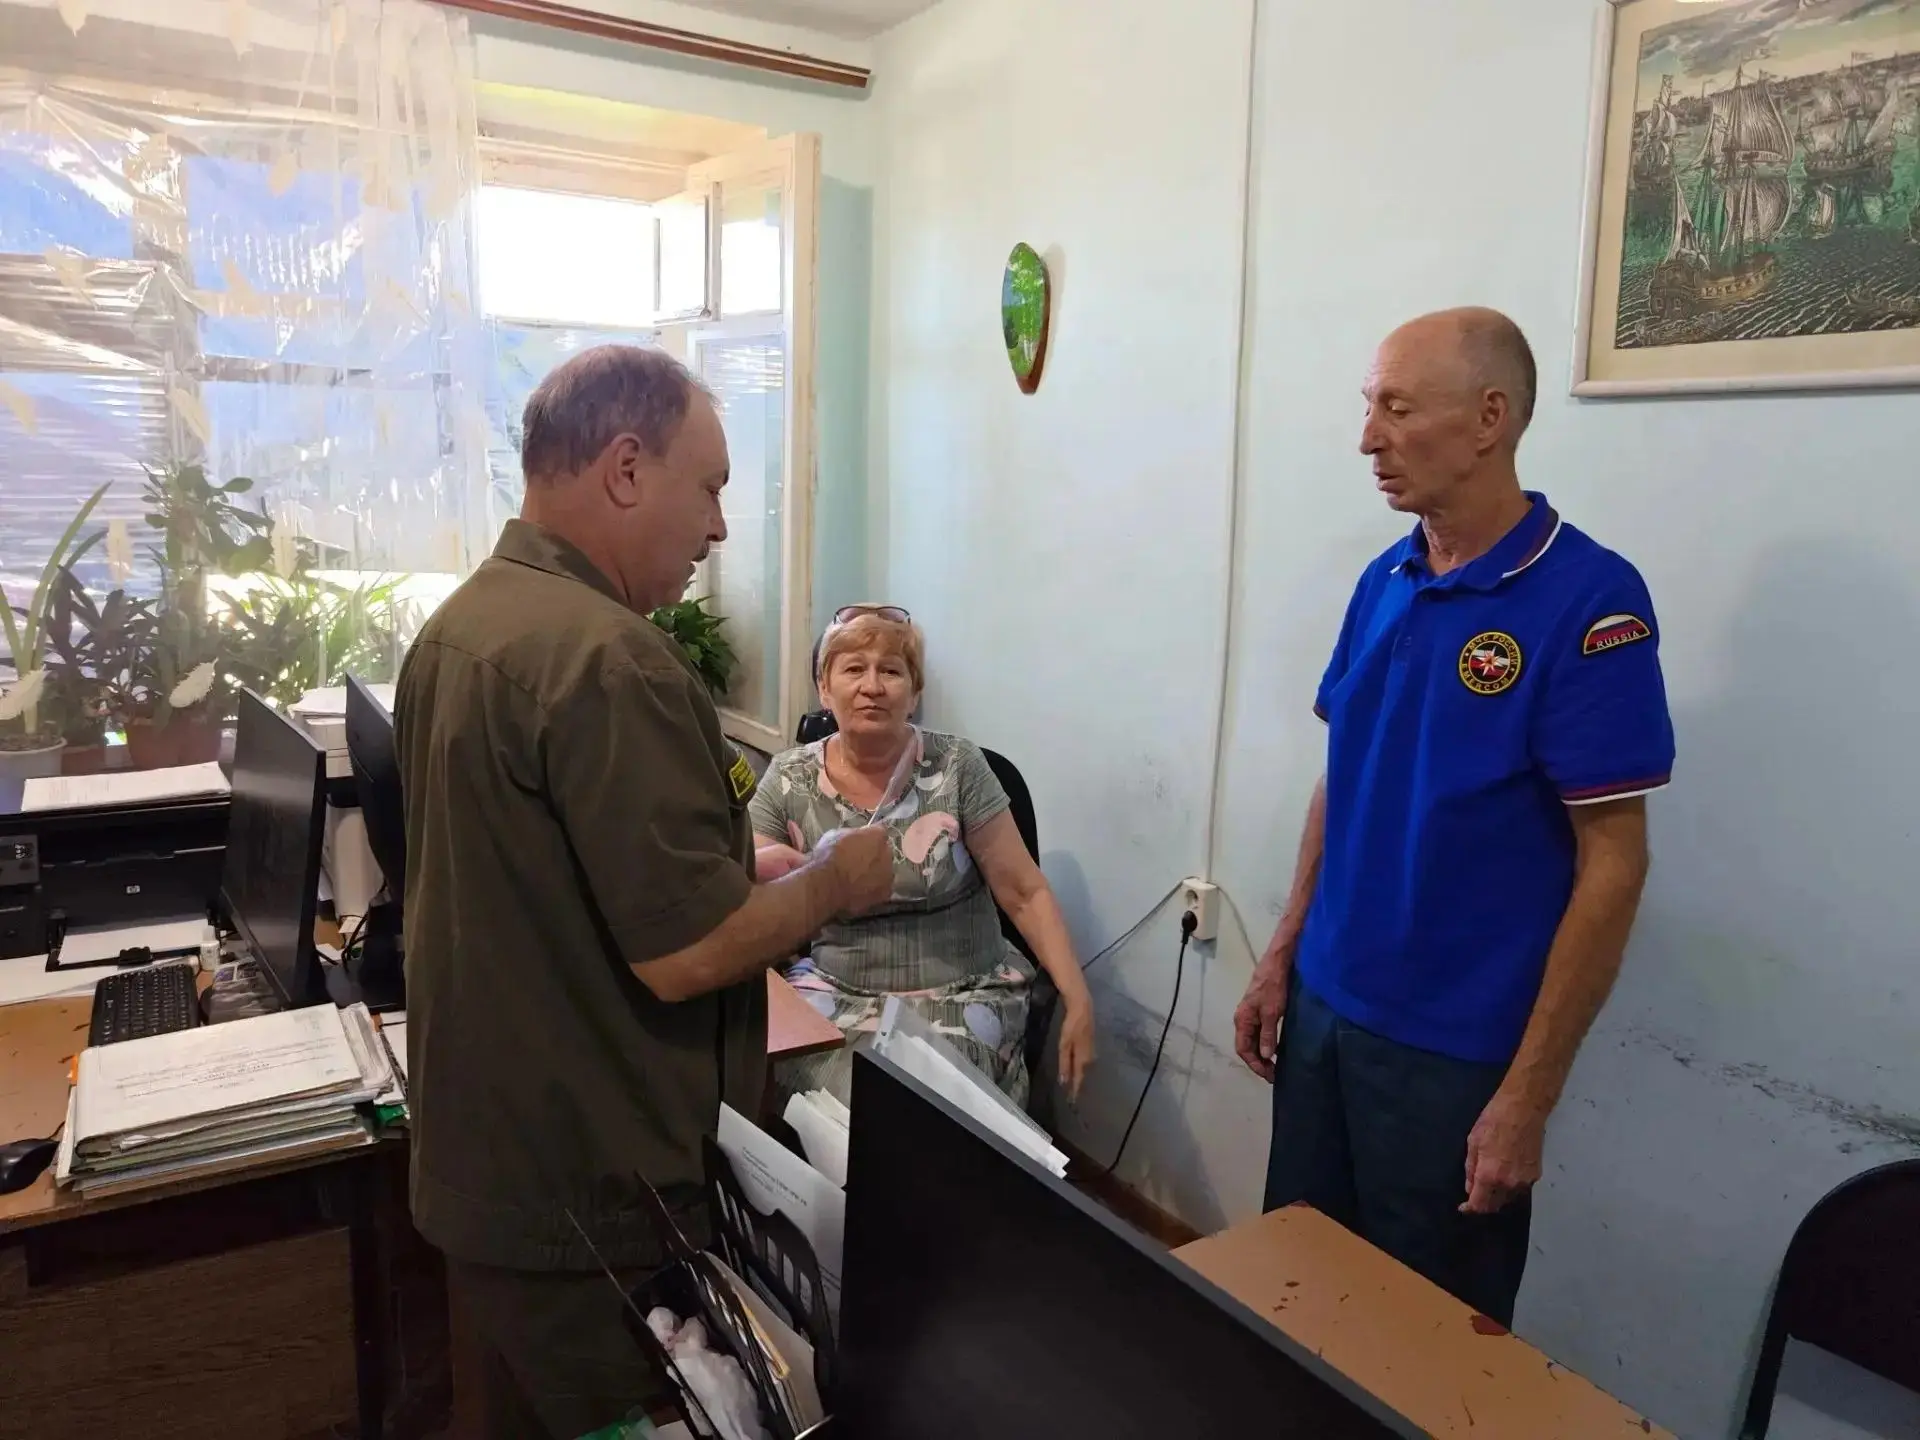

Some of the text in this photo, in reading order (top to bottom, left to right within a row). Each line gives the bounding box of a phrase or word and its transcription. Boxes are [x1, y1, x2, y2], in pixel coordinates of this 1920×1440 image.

[1469, 634, 1518, 664] МЧС РОССИИ
[1596, 630, 1640, 649] RUSSIA
